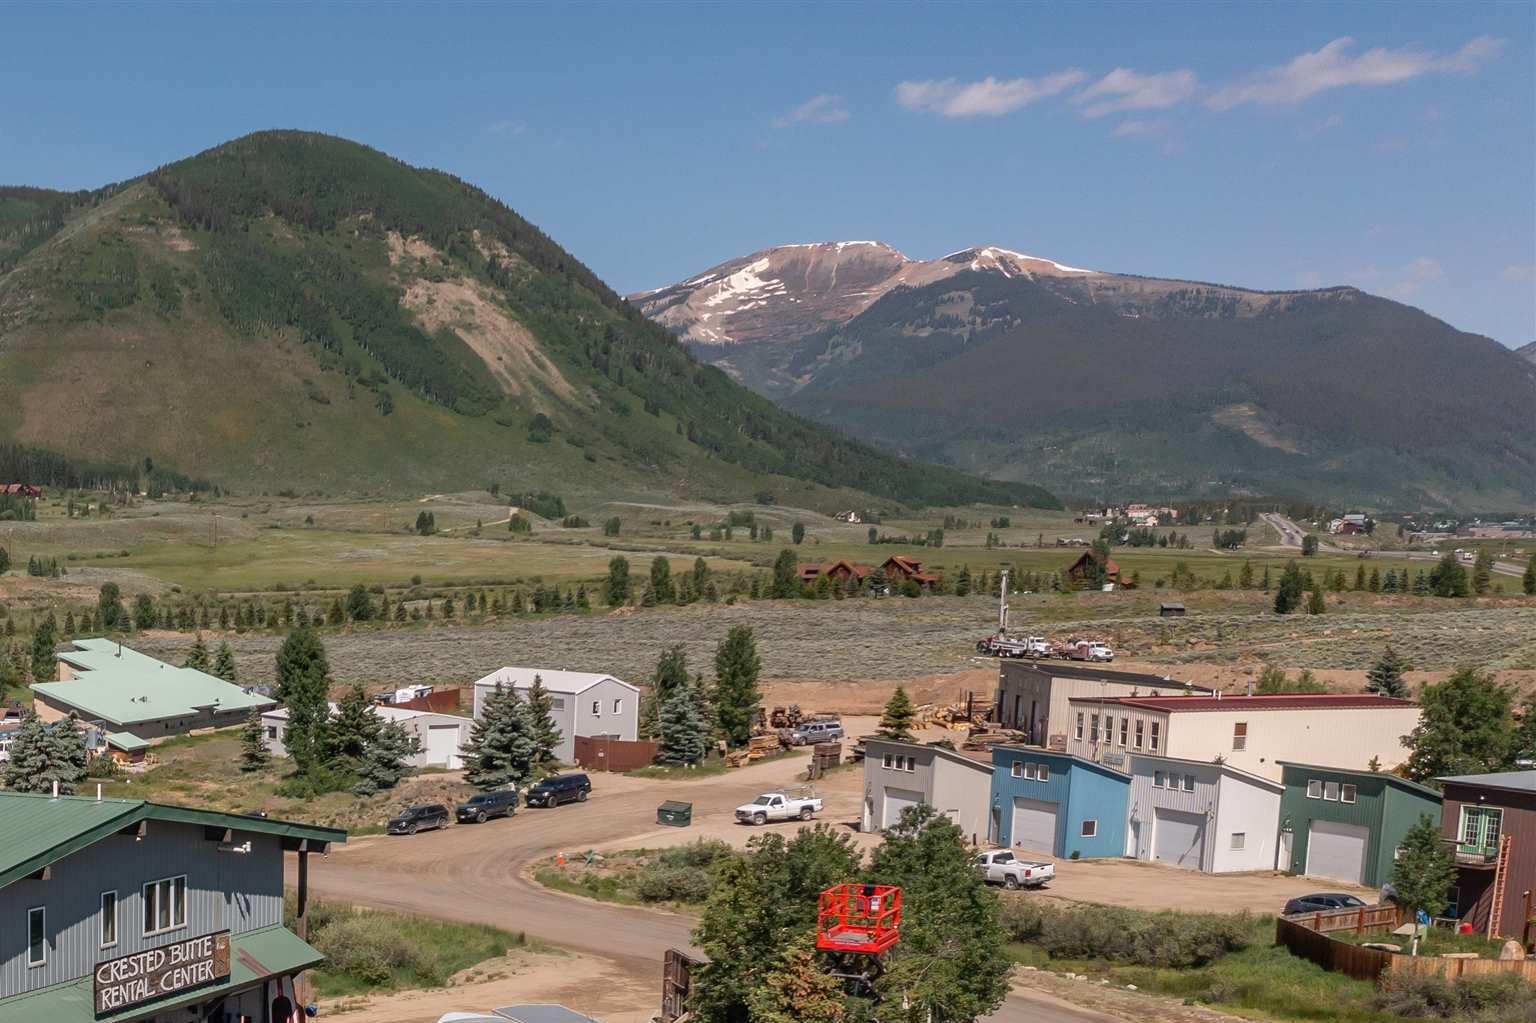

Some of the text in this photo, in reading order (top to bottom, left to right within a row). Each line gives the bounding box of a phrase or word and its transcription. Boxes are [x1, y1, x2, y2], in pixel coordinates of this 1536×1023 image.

[96, 935, 212, 985] CRESTED BUTTE
[101, 961, 215, 1010] RENTAL CENTER
